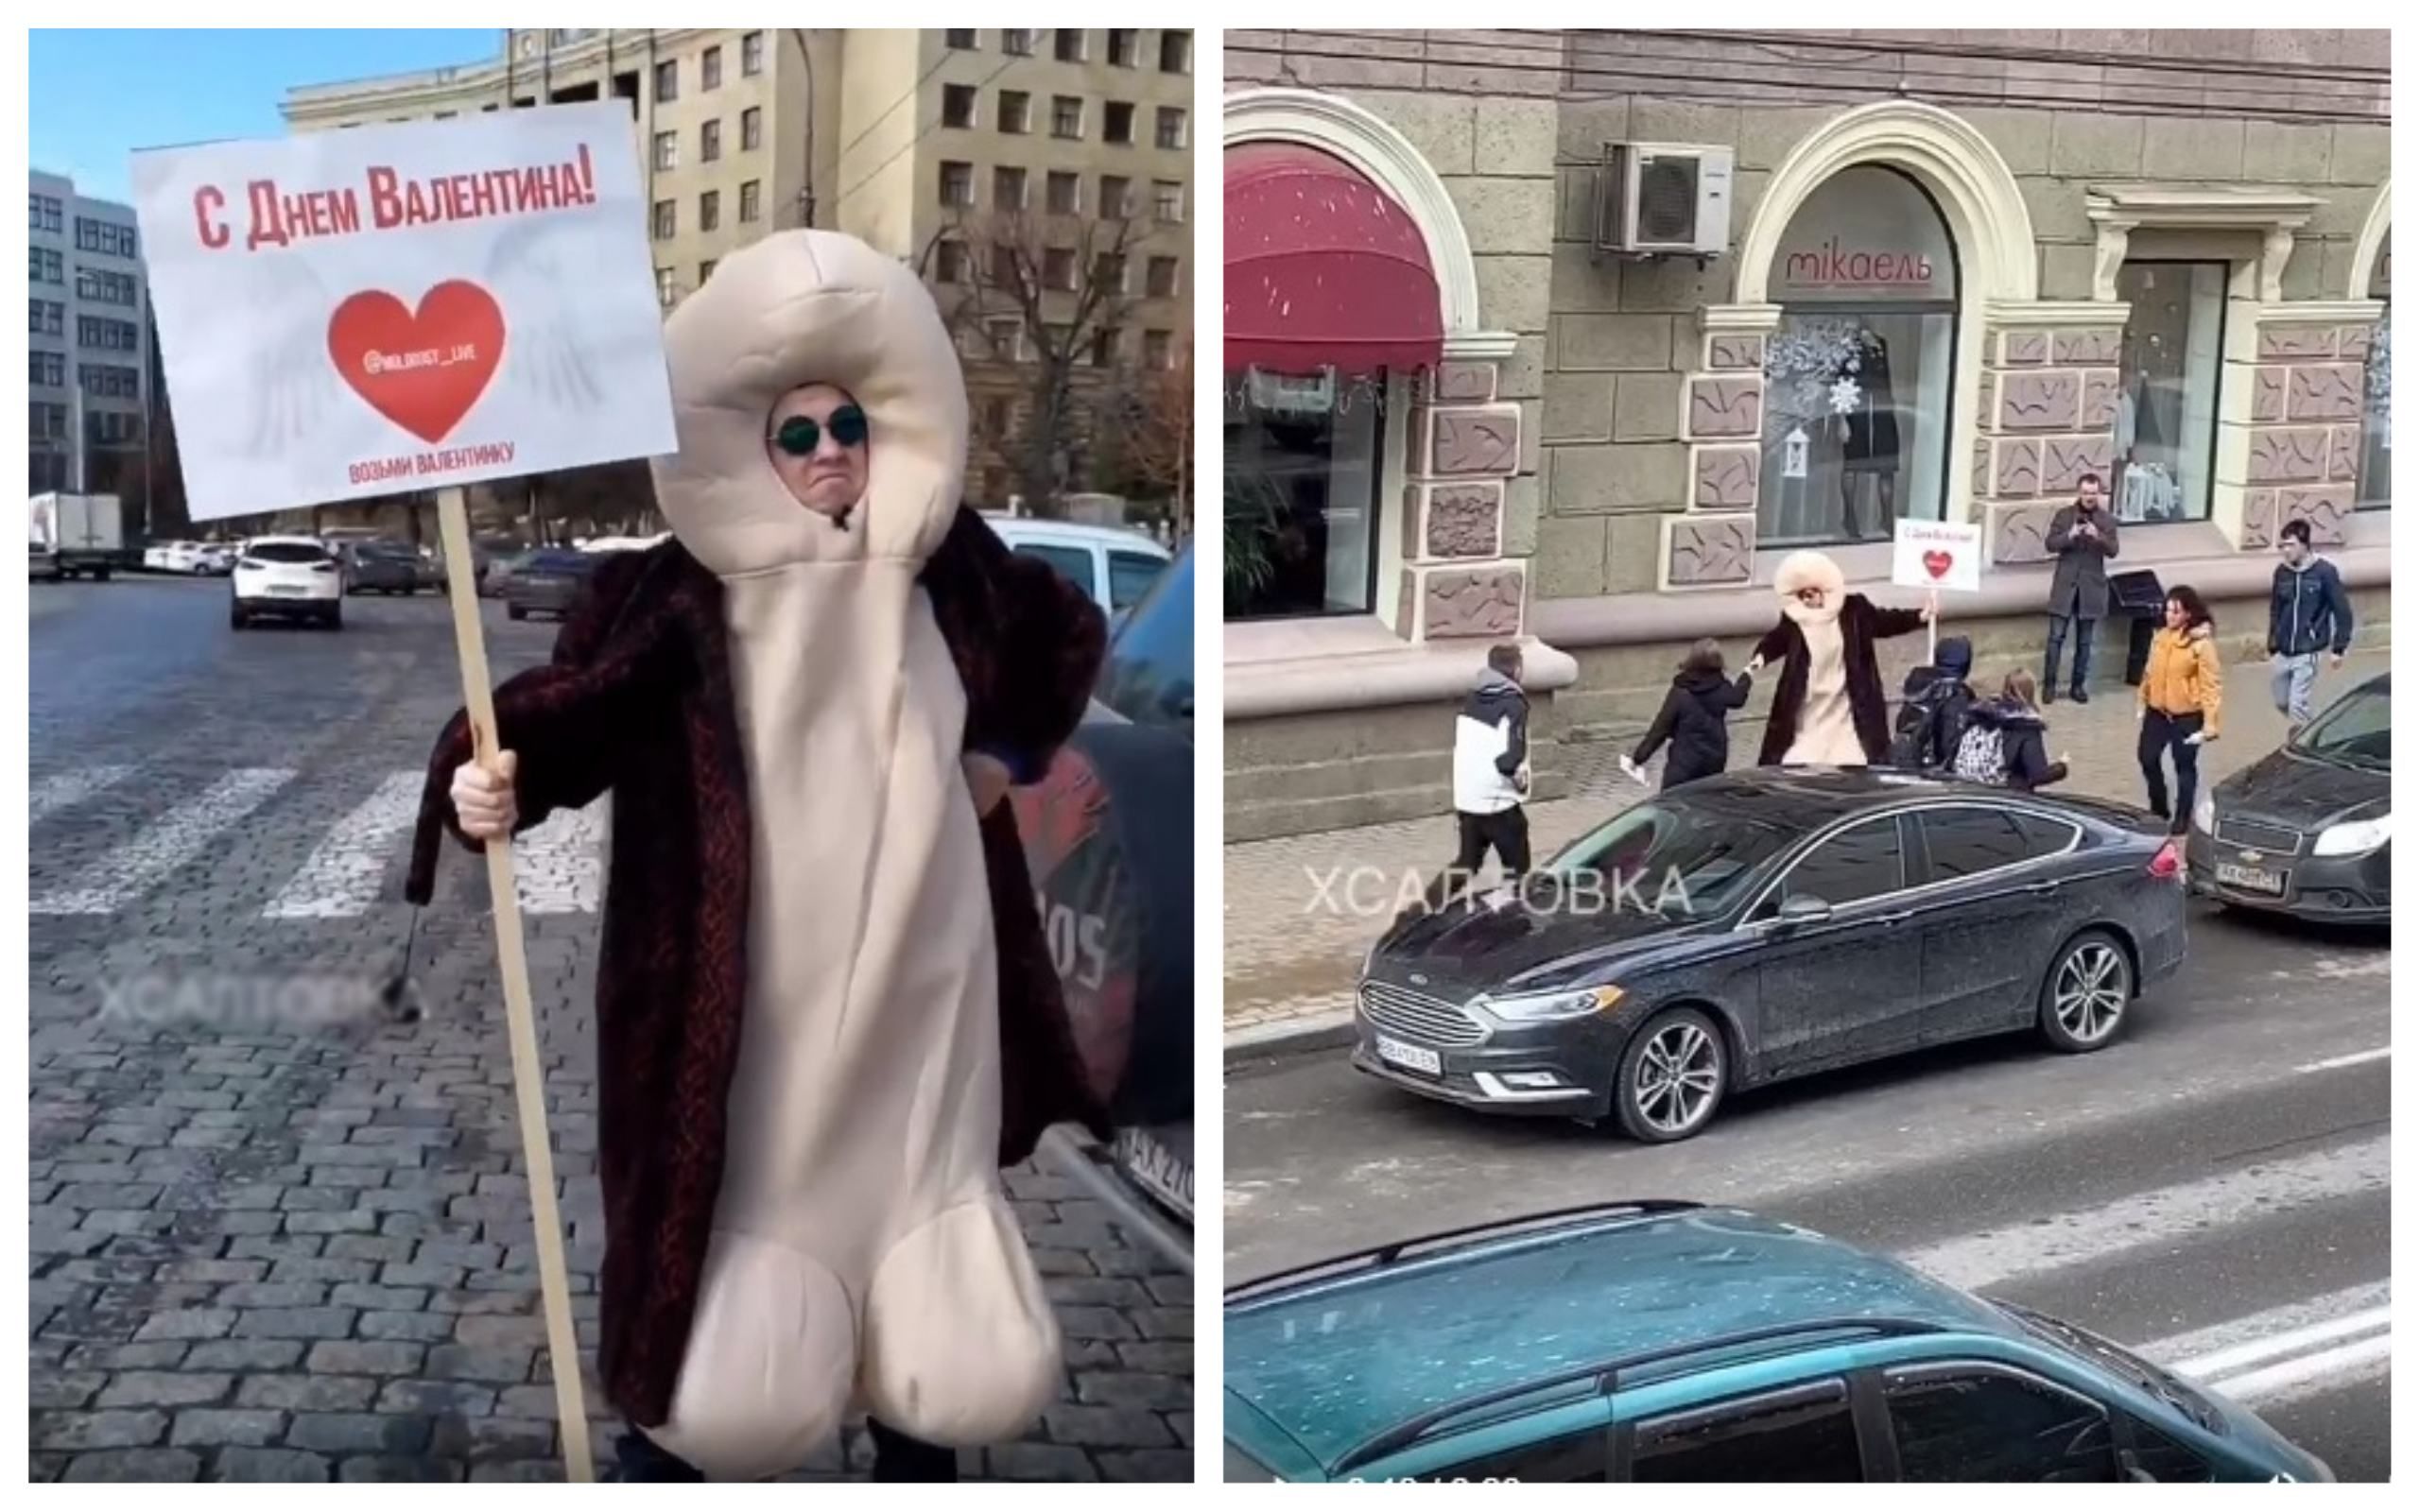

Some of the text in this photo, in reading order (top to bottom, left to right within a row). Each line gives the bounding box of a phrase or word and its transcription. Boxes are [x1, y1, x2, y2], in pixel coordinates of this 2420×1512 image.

[194, 185, 230, 249] С
[349, 441, 515, 484] ВОЗЬМИ ВАЛЕНТИНКУ
